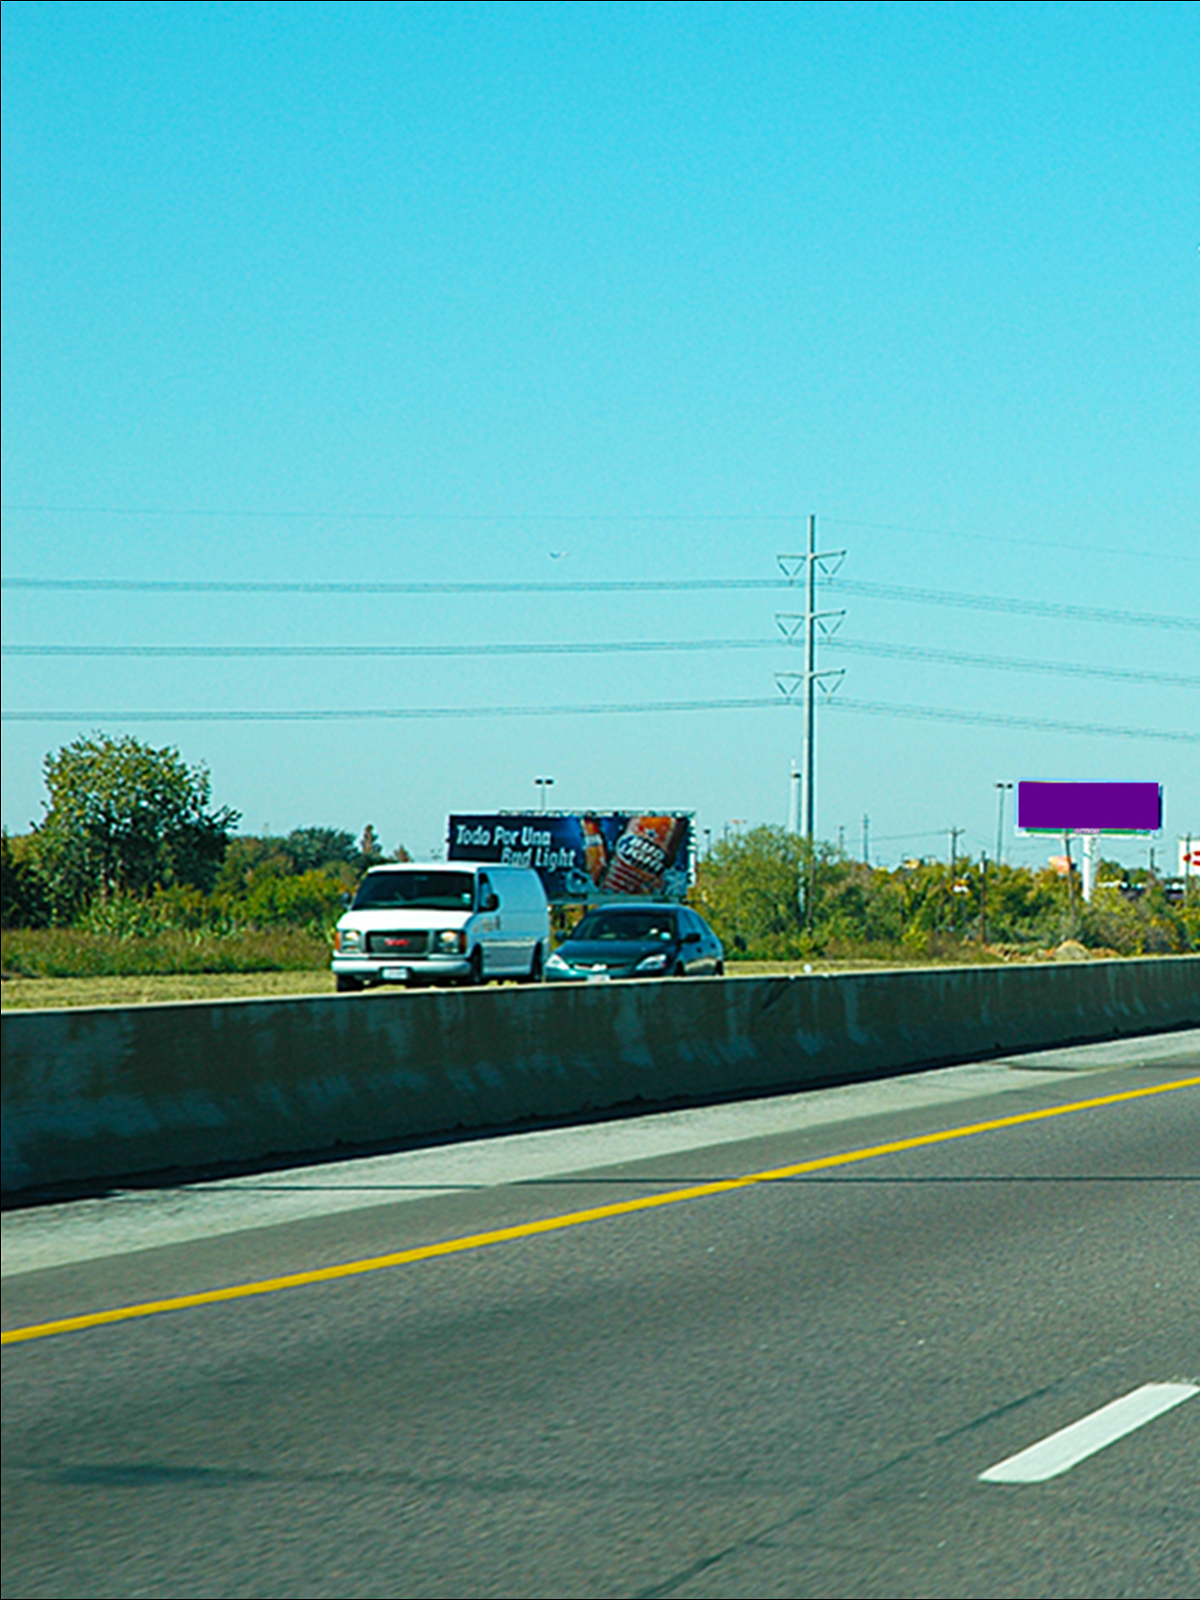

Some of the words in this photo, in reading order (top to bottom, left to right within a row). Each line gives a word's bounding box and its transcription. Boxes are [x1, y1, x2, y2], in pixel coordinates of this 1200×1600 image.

[456, 825, 491, 846] Todo
[493, 826, 520, 846] Por
[521, 826, 551, 846] Una
[501, 847, 532, 867] Bud
[535, 847, 576, 872] Light
